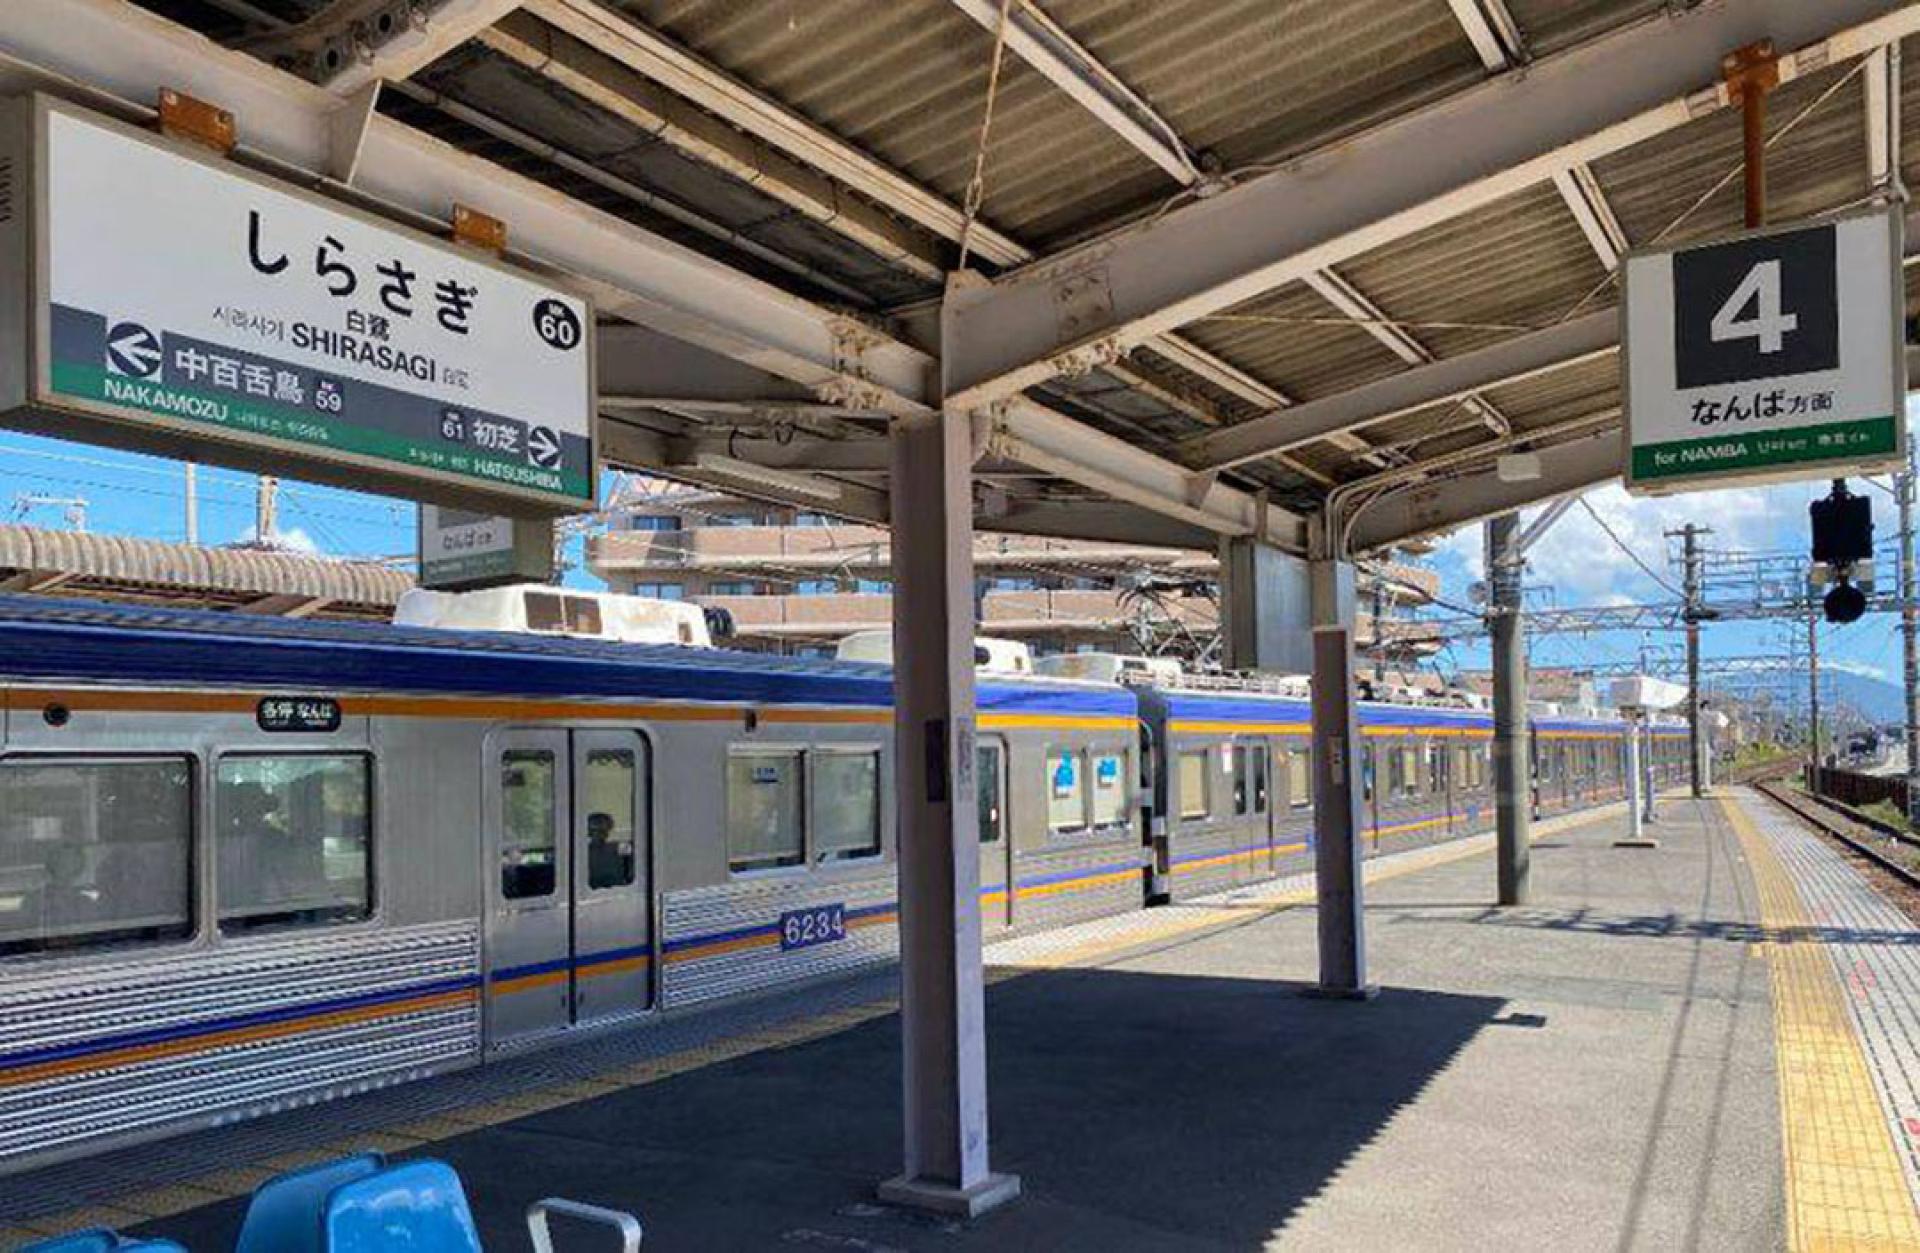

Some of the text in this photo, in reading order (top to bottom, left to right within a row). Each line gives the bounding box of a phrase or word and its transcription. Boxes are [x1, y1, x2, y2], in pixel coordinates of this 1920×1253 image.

[248, 210, 479, 335] しらさぎ
[1709, 258, 1799, 354] 4
[541, 315, 575, 345] 60
[291, 322, 435, 383] SHIRASAGI
[175, 347, 306, 405] 中百舌鳥
[103, 379, 229, 422] NAKAMOZU
[315, 390, 342, 412] 59
[442, 420, 464, 439] 61
[473, 418, 521, 454] 初芝
[1654, 451, 1678, 468] for
[1681, 443, 1749, 463] NAMBA
[473, 458, 563, 491] HATSUSHIBA
[785, 908, 844, 944] 6234
